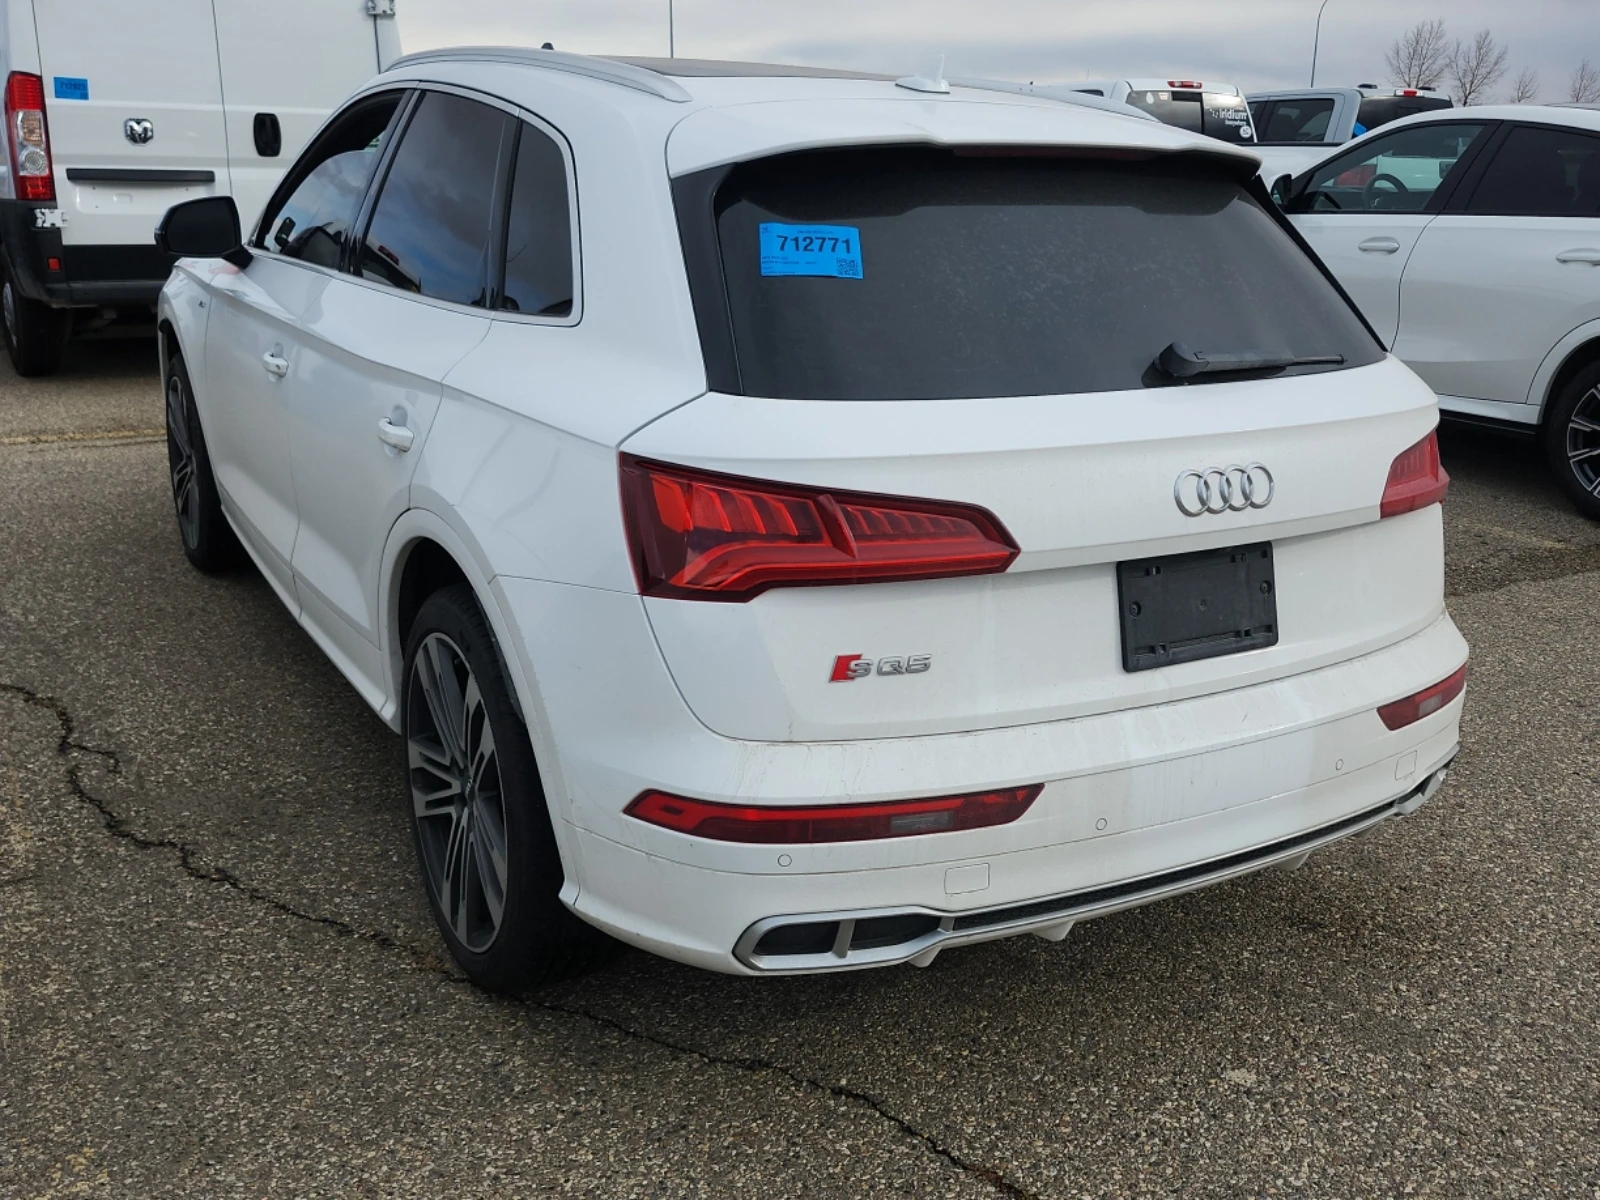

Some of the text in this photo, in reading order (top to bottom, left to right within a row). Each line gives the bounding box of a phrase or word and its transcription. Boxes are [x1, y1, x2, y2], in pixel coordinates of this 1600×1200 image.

[1219, 108, 1247, 120] Iridium
[776, 234, 851, 254] 712771
[846, 653, 932, 677] SQ5
